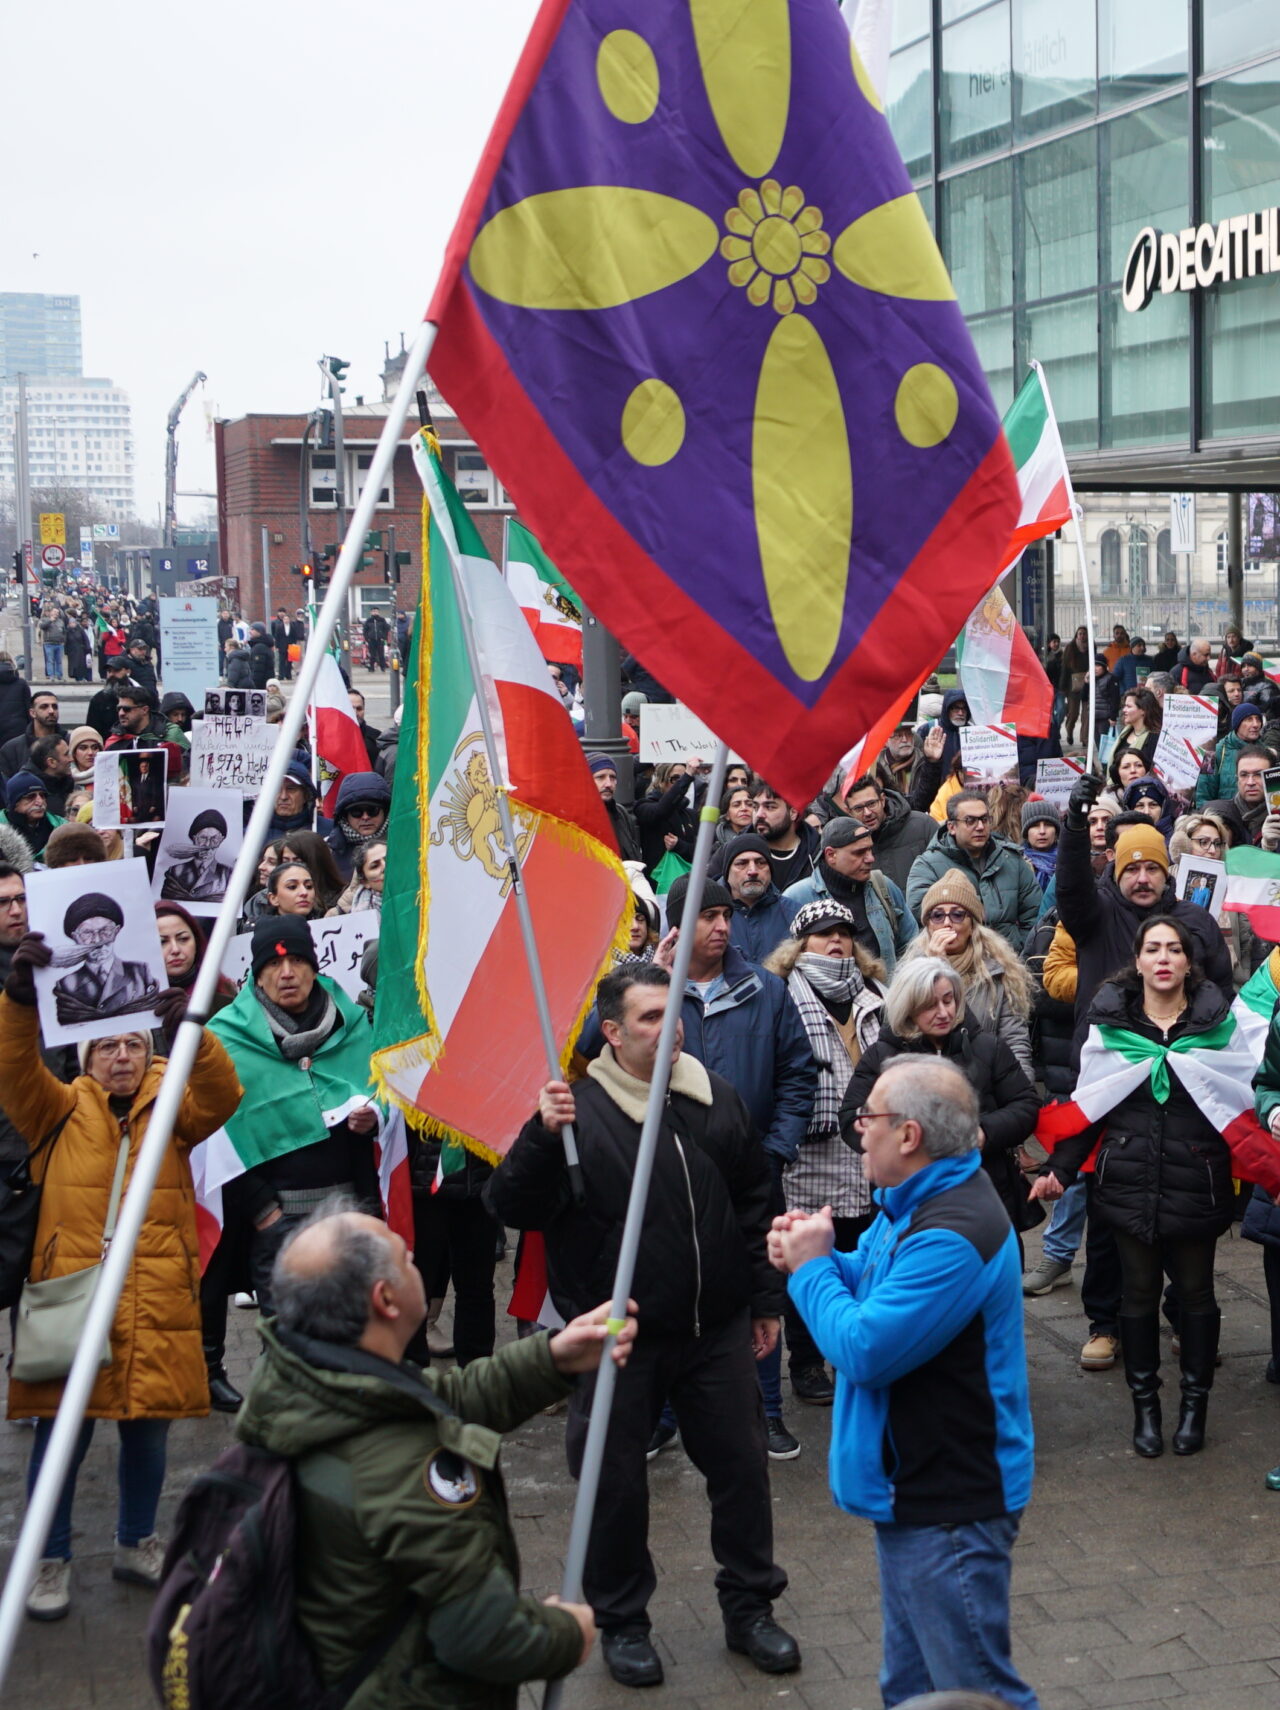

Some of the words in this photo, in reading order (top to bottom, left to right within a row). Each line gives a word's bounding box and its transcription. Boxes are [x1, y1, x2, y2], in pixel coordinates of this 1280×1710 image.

[969, 63, 995, 98] hier
[164, 560, 172, 571] 8
[195, 560, 208, 571] 12
[1172, 704, 1201, 712] Solidarität
[215, 716, 253, 736] HELP
[969, 734, 999, 744] Solidarität
[665, 739, 688, 753] The
[1045, 767, 1070, 776] Solidarität
